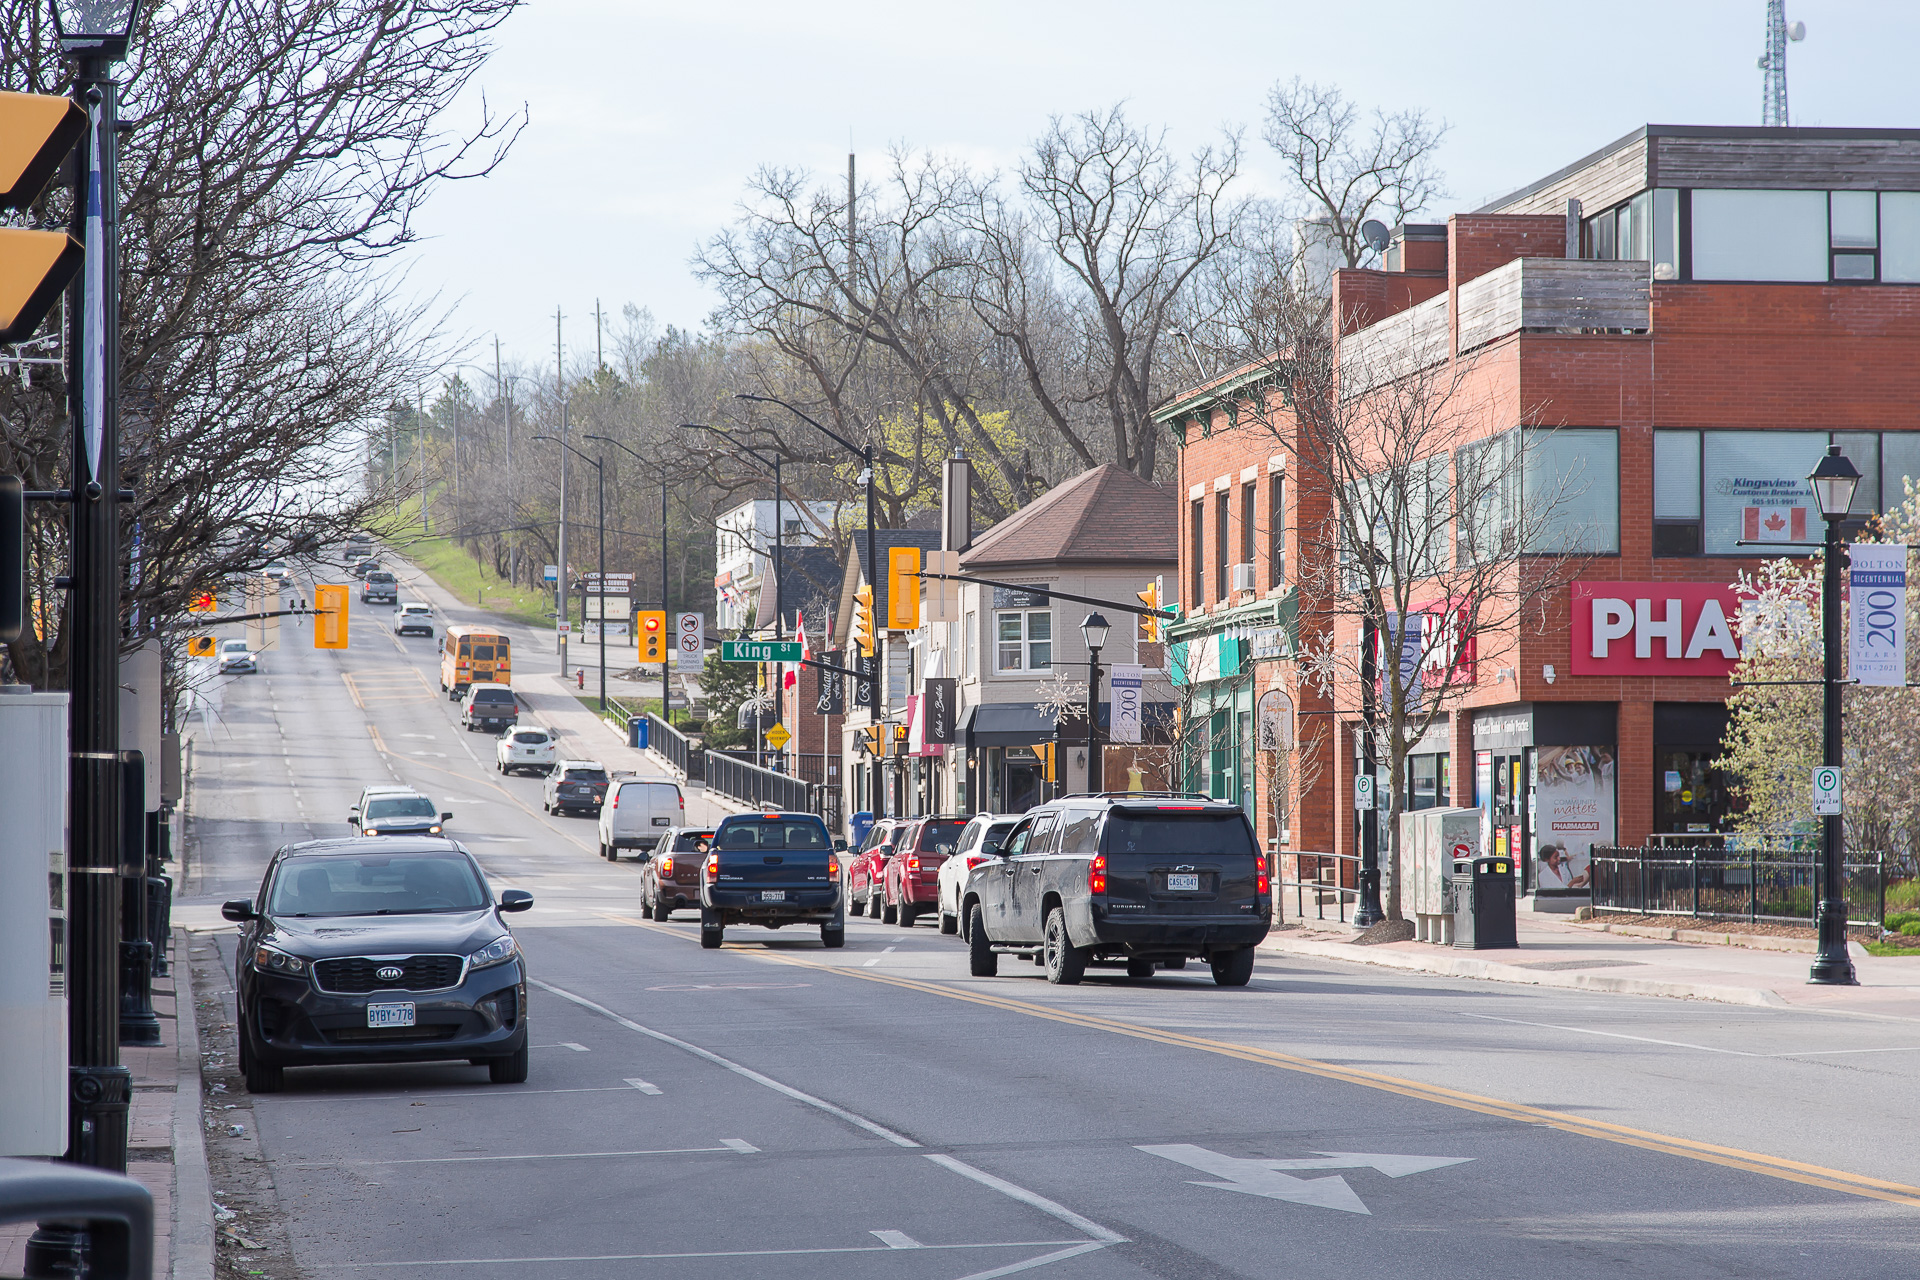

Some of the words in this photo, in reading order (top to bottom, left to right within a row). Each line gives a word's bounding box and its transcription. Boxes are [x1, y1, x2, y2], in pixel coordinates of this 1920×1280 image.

[1734, 478, 1798, 489] Kingsview
[1852, 560, 1903, 569] BOLTON
[1853, 575, 1904, 583] BICENTENNIAL
[1866, 590, 1897, 648] 200
[733, 643, 771, 660] King
[780, 643, 791, 652] St
[817, 654, 832, 711] Restaurnt
[1121, 689, 1137, 722] 200
[1553, 803, 1598, 815] matters
[1553, 822, 1598, 830] PHARMASAVE
[1168, 878, 1183, 886] CASL
[1186, 878, 1197, 886] 047
[380, 969, 399, 978] KIA
[369, 1009, 391, 1022] BYBY
[396, 1008, 413, 1021] 778
